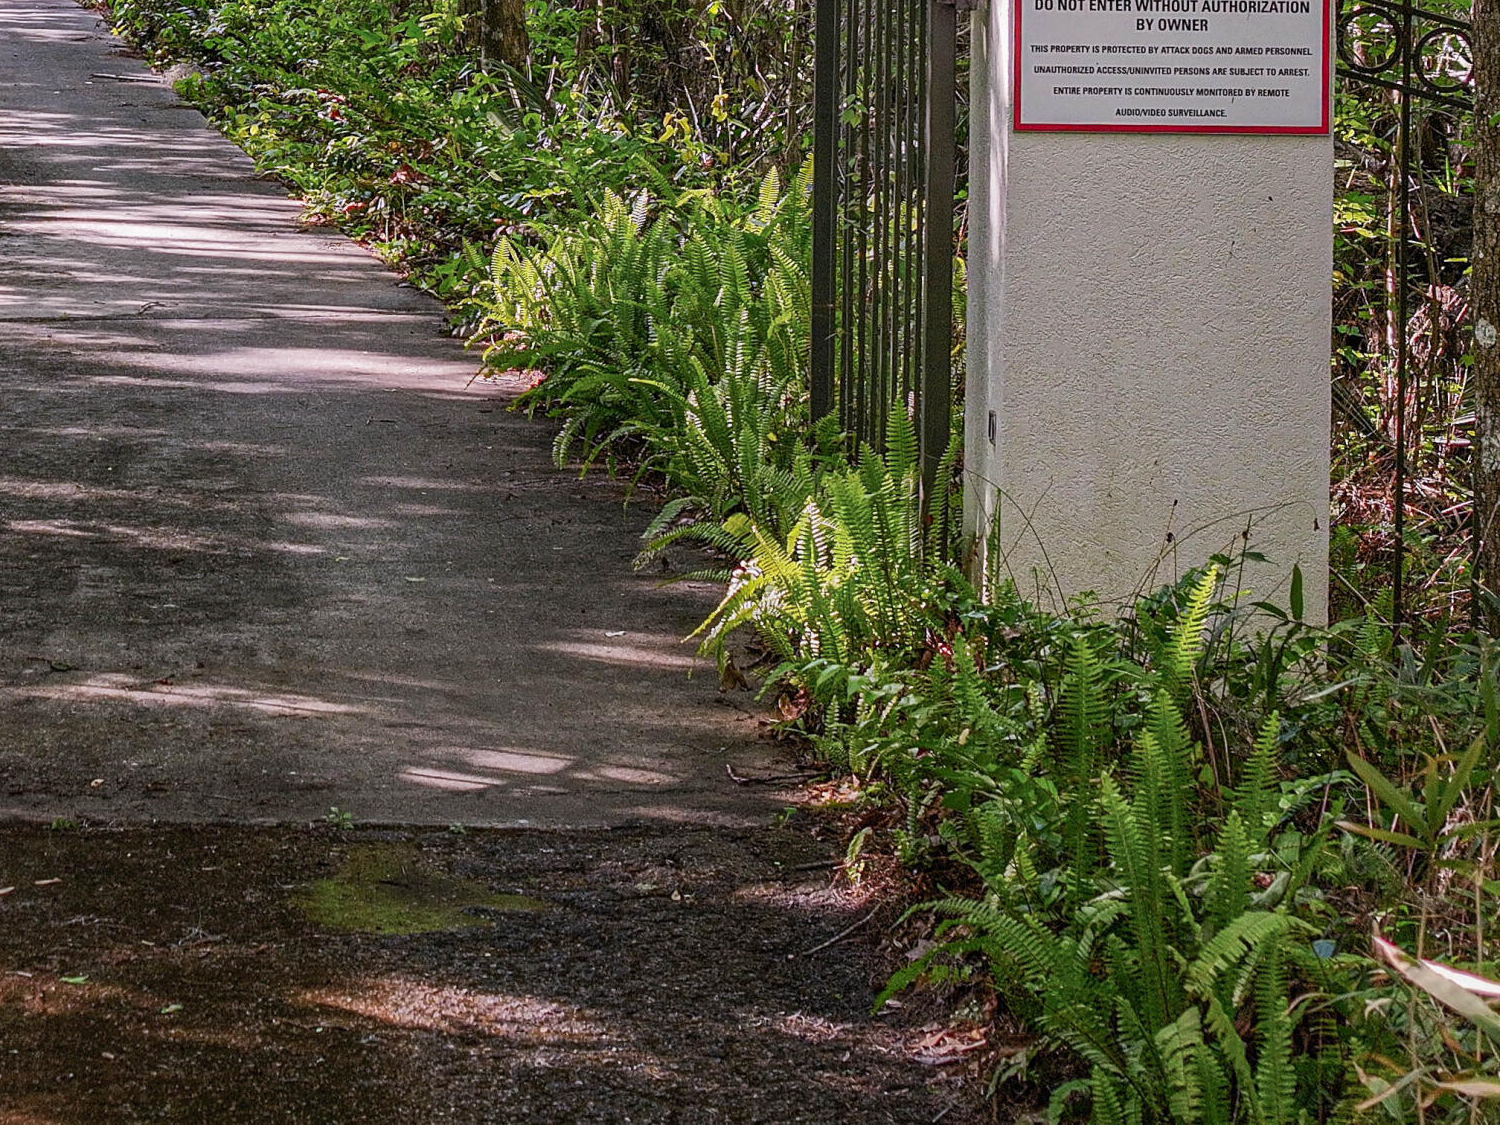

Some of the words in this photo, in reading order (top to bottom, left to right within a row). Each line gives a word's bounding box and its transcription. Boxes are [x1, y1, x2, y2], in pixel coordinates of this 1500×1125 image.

[1134, 0, 1199, 13] WITHOUT
[1201, 0, 1310, 14] AUTHORIZATION
[1136, 18, 1155, 31] BY
[1157, 18, 1209, 32] OWNER
[1030, 44, 1049, 53] THIS
[1049, 44, 1091, 54] PROPERTY
[1091, 45, 1100, 54] IS
[1101, 45, 1147, 54] PROTECTED
[1148, 46, 1159, 55] BY
[1160, 46, 1191, 55] ATTACK
[1191, 46, 1214, 55] DOGS
[1215, 46, 1234, 55] AND
[1234, 46, 1264, 56] ARMED
[1033, 65, 1095, 75] UNAUTHORIZED
[1095, 66, 1172, 75] ACCESS/UNINVITED
[1173, 67, 1211, 76] PERSONS
[1211, 67, 1228, 76] ARE
[1228, 67, 1265, 76] SUBJECT
[1265, 67, 1277, 77] TO
[1277, 68, 1310, 77] ARREST.
[1053, 86, 1081, 95] ENTIRE
[1082, 86, 1123, 96] PROPERTY
[1124, 87, 1133, 96] IS
[1134, 87, 1195, 96] CONTINUOUSLY
[1195, 88, 1244, 97] MONITORED
[1244, 88, 1257, 97] BY
[1257, 88, 1290, 98] REMOTE
[1115, 108, 1167, 117] AUDIO/VIDEO
